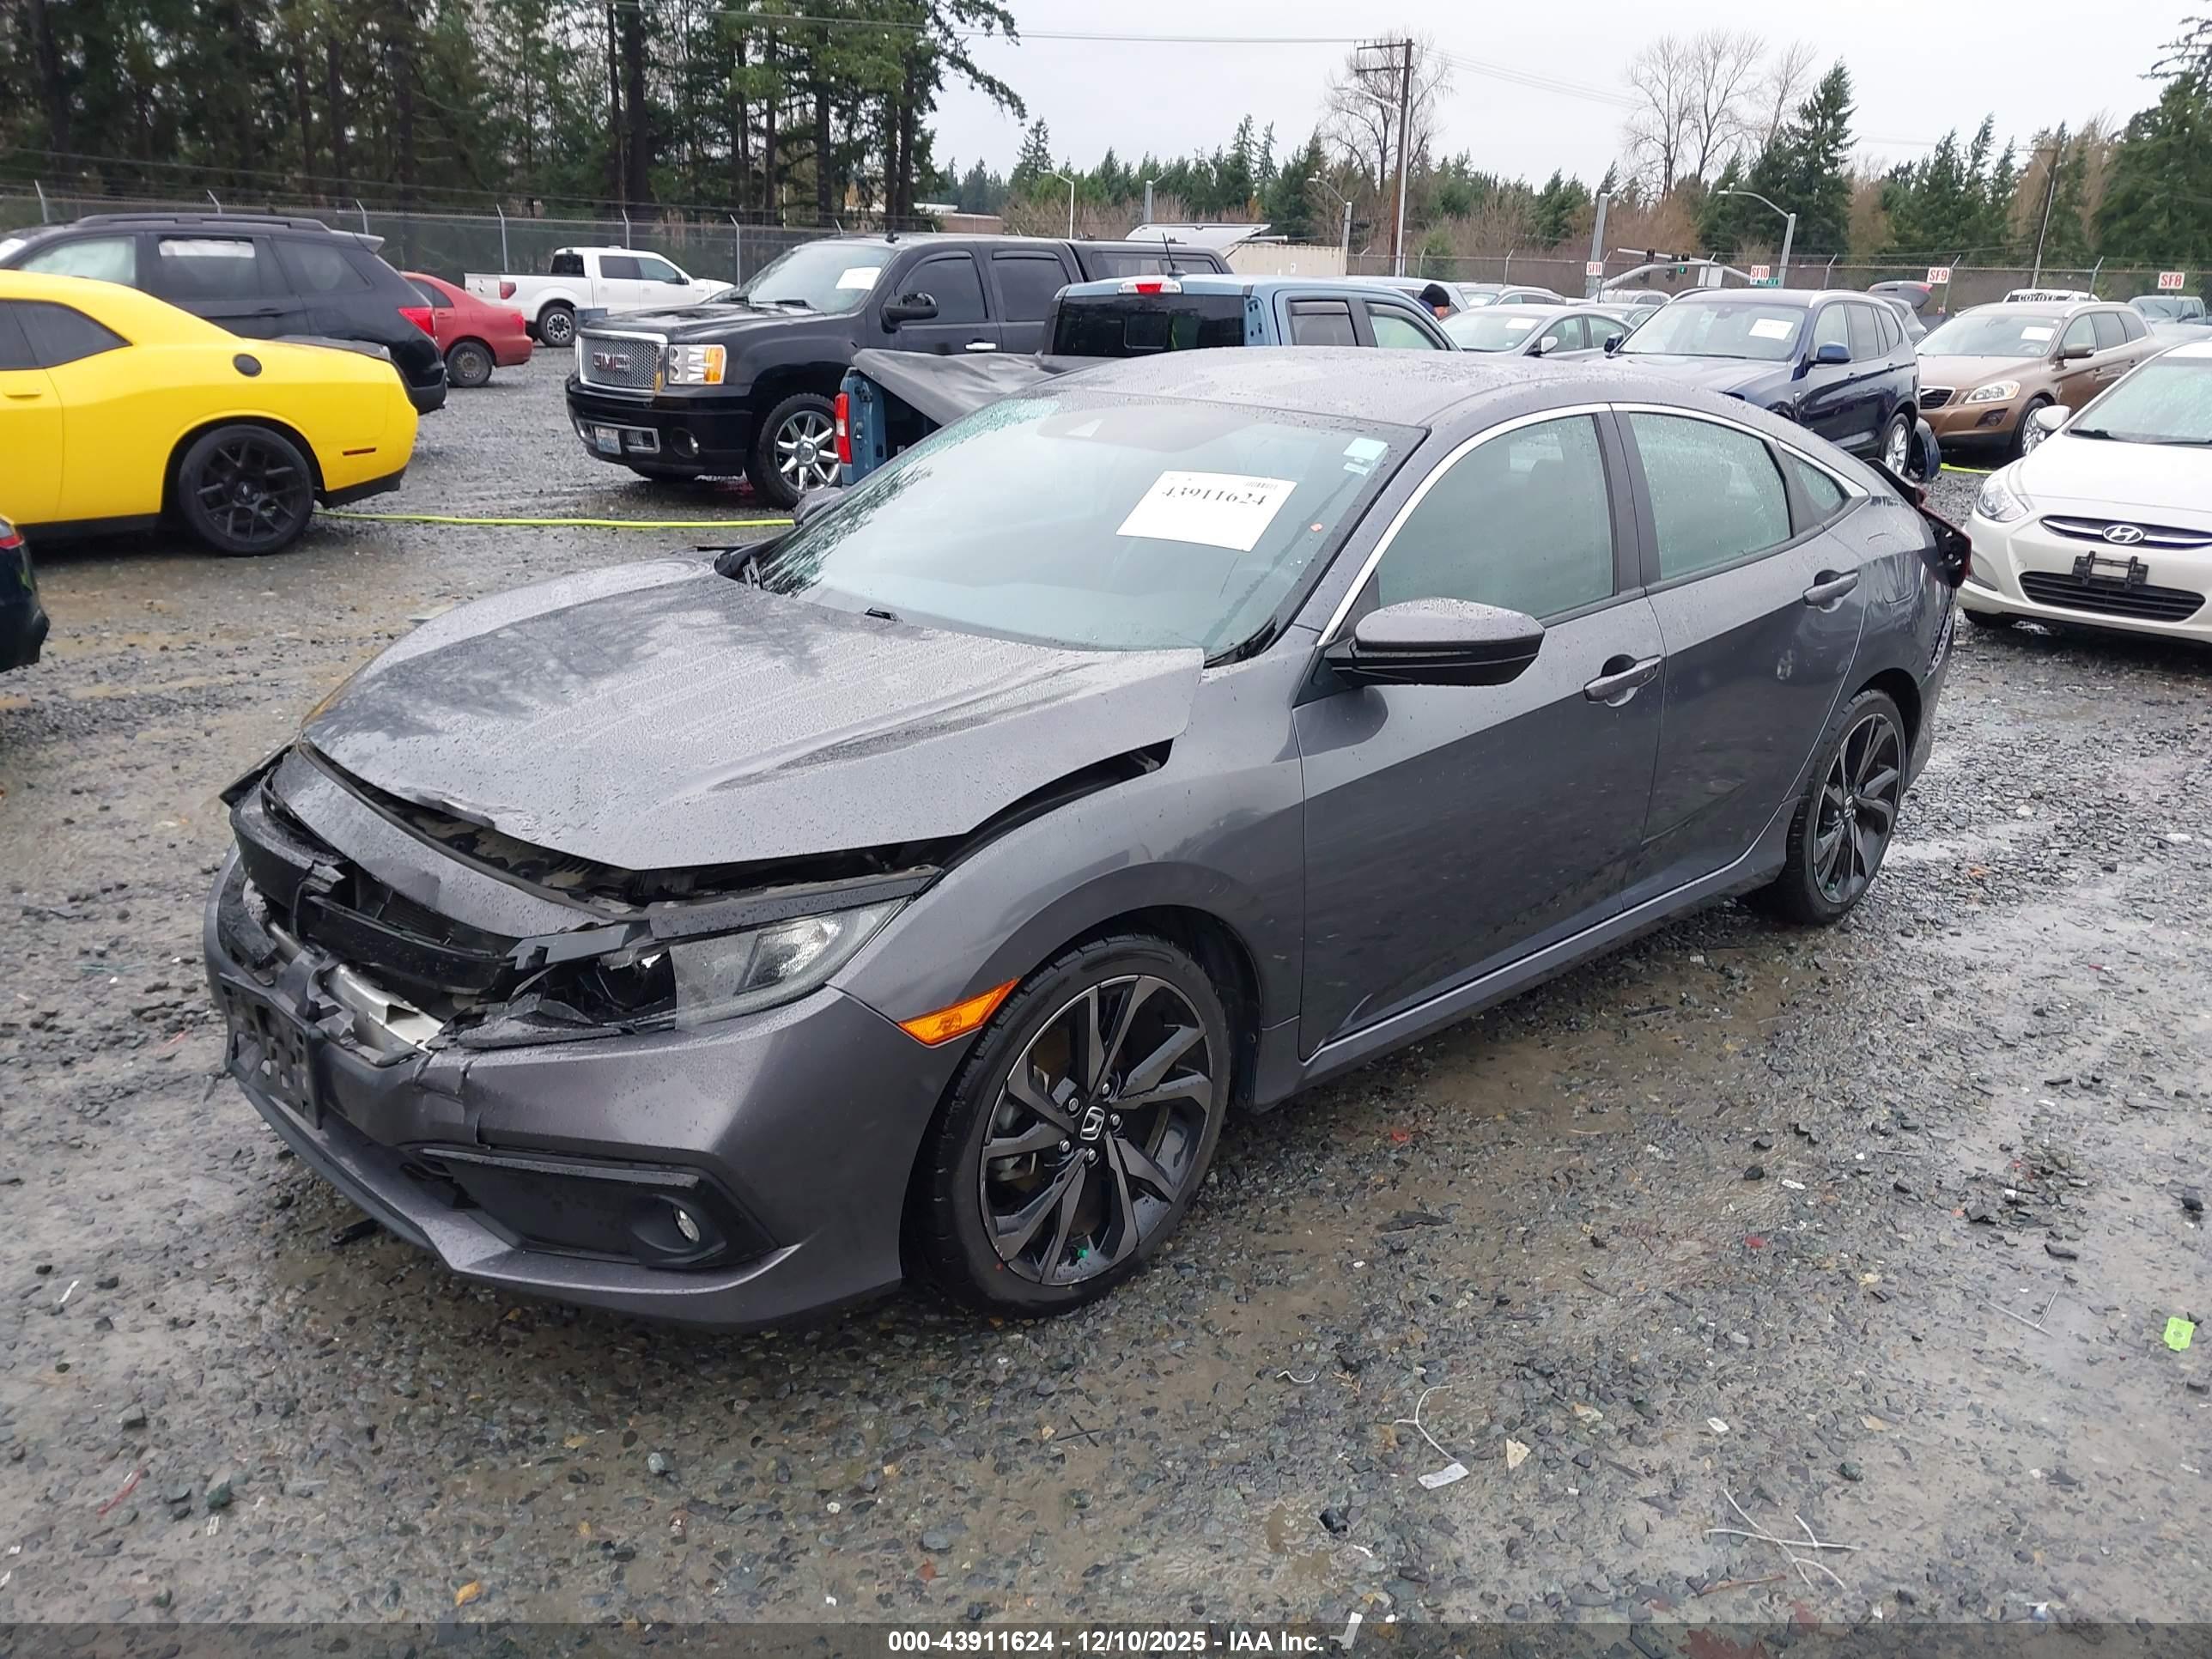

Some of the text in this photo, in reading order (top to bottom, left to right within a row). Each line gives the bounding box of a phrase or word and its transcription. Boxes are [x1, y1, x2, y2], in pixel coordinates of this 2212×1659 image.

[1751, 267, 1769, 278] SF10
[1929, 269, 1948, 282] SF9
[2160, 274, 2182, 287] SF8
[592, 352, 630, 371] GMC
[1162, 486, 1267, 506] 43911624
